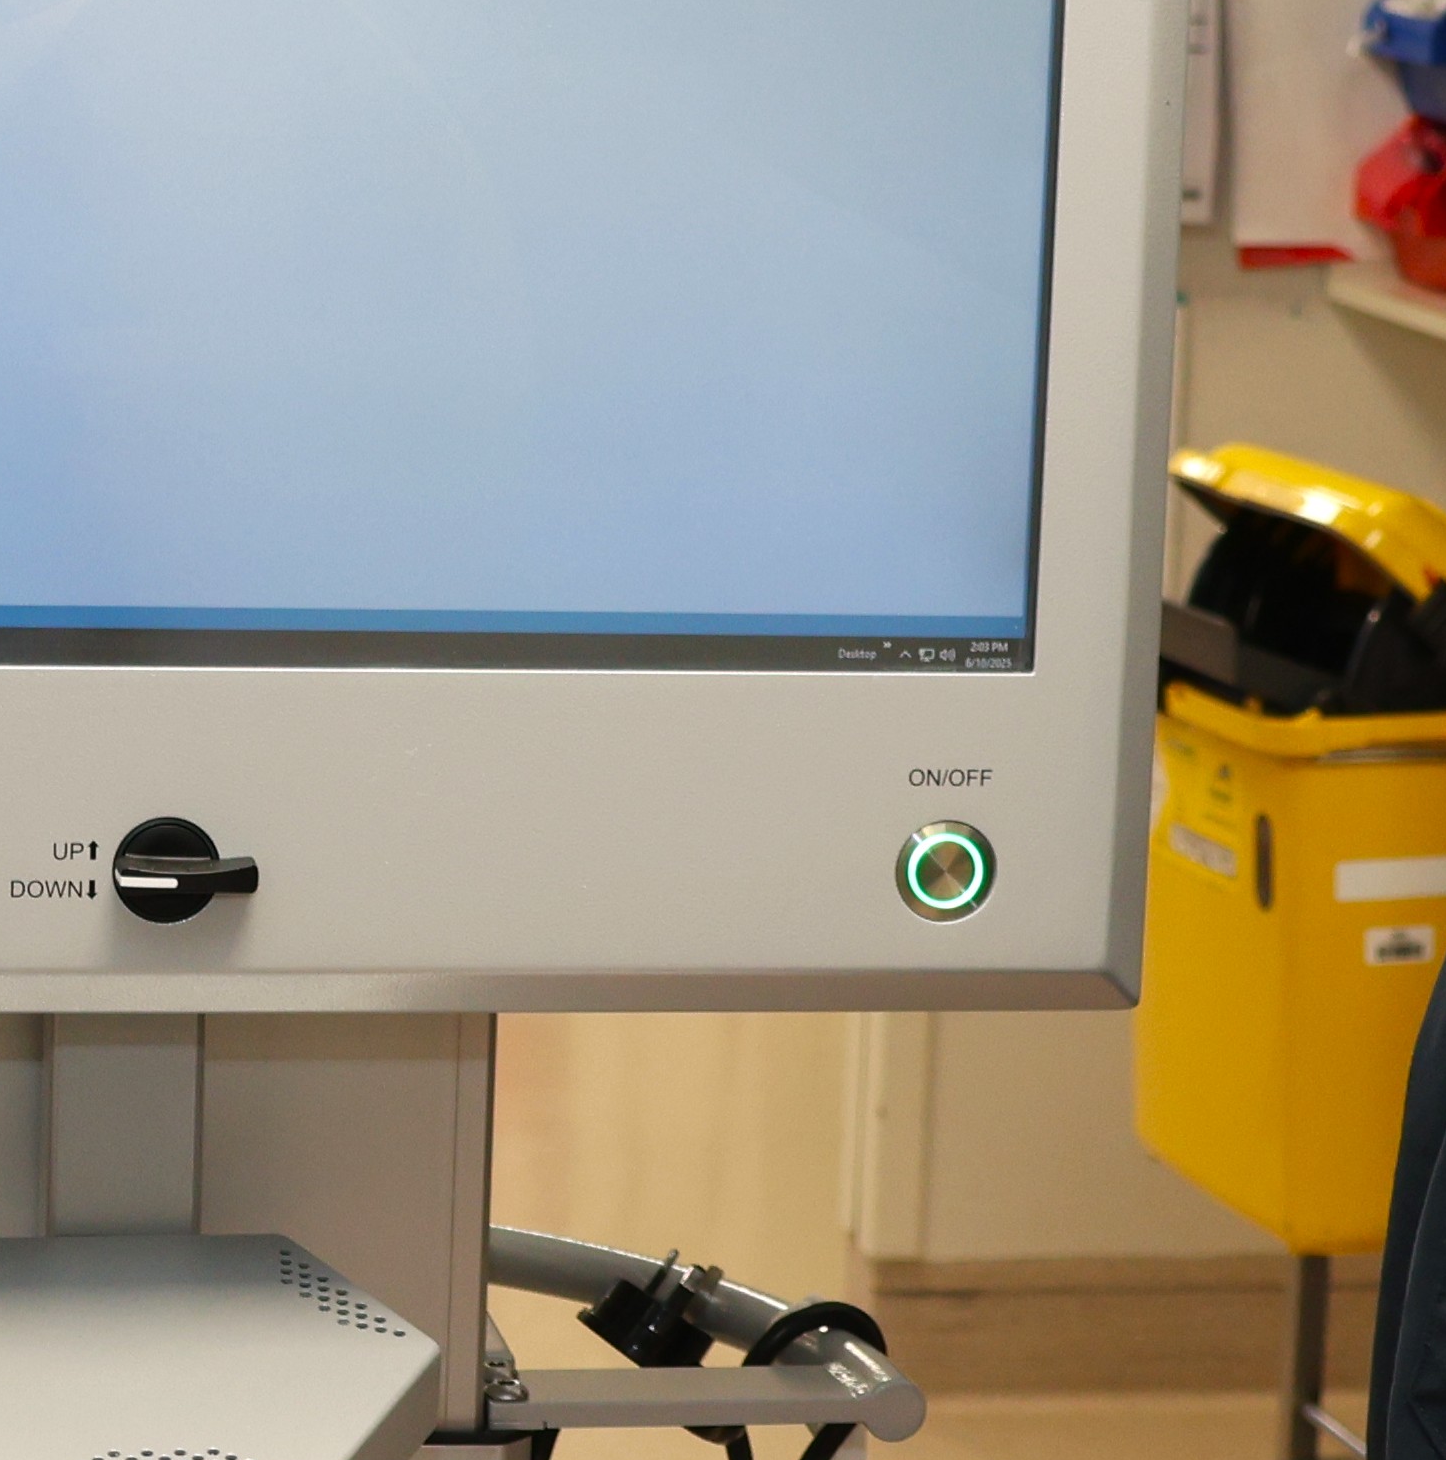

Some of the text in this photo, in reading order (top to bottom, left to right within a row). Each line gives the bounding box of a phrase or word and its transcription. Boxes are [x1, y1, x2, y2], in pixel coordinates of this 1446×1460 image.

[837, 648, 878, 661] Desktop
[969, 641, 1009, 653] 2:03 PM
[908, 768, 994, 788] ON/OFF
[51, 842, 86, 860] UP
[9, 880, 85, 900] DOWN
